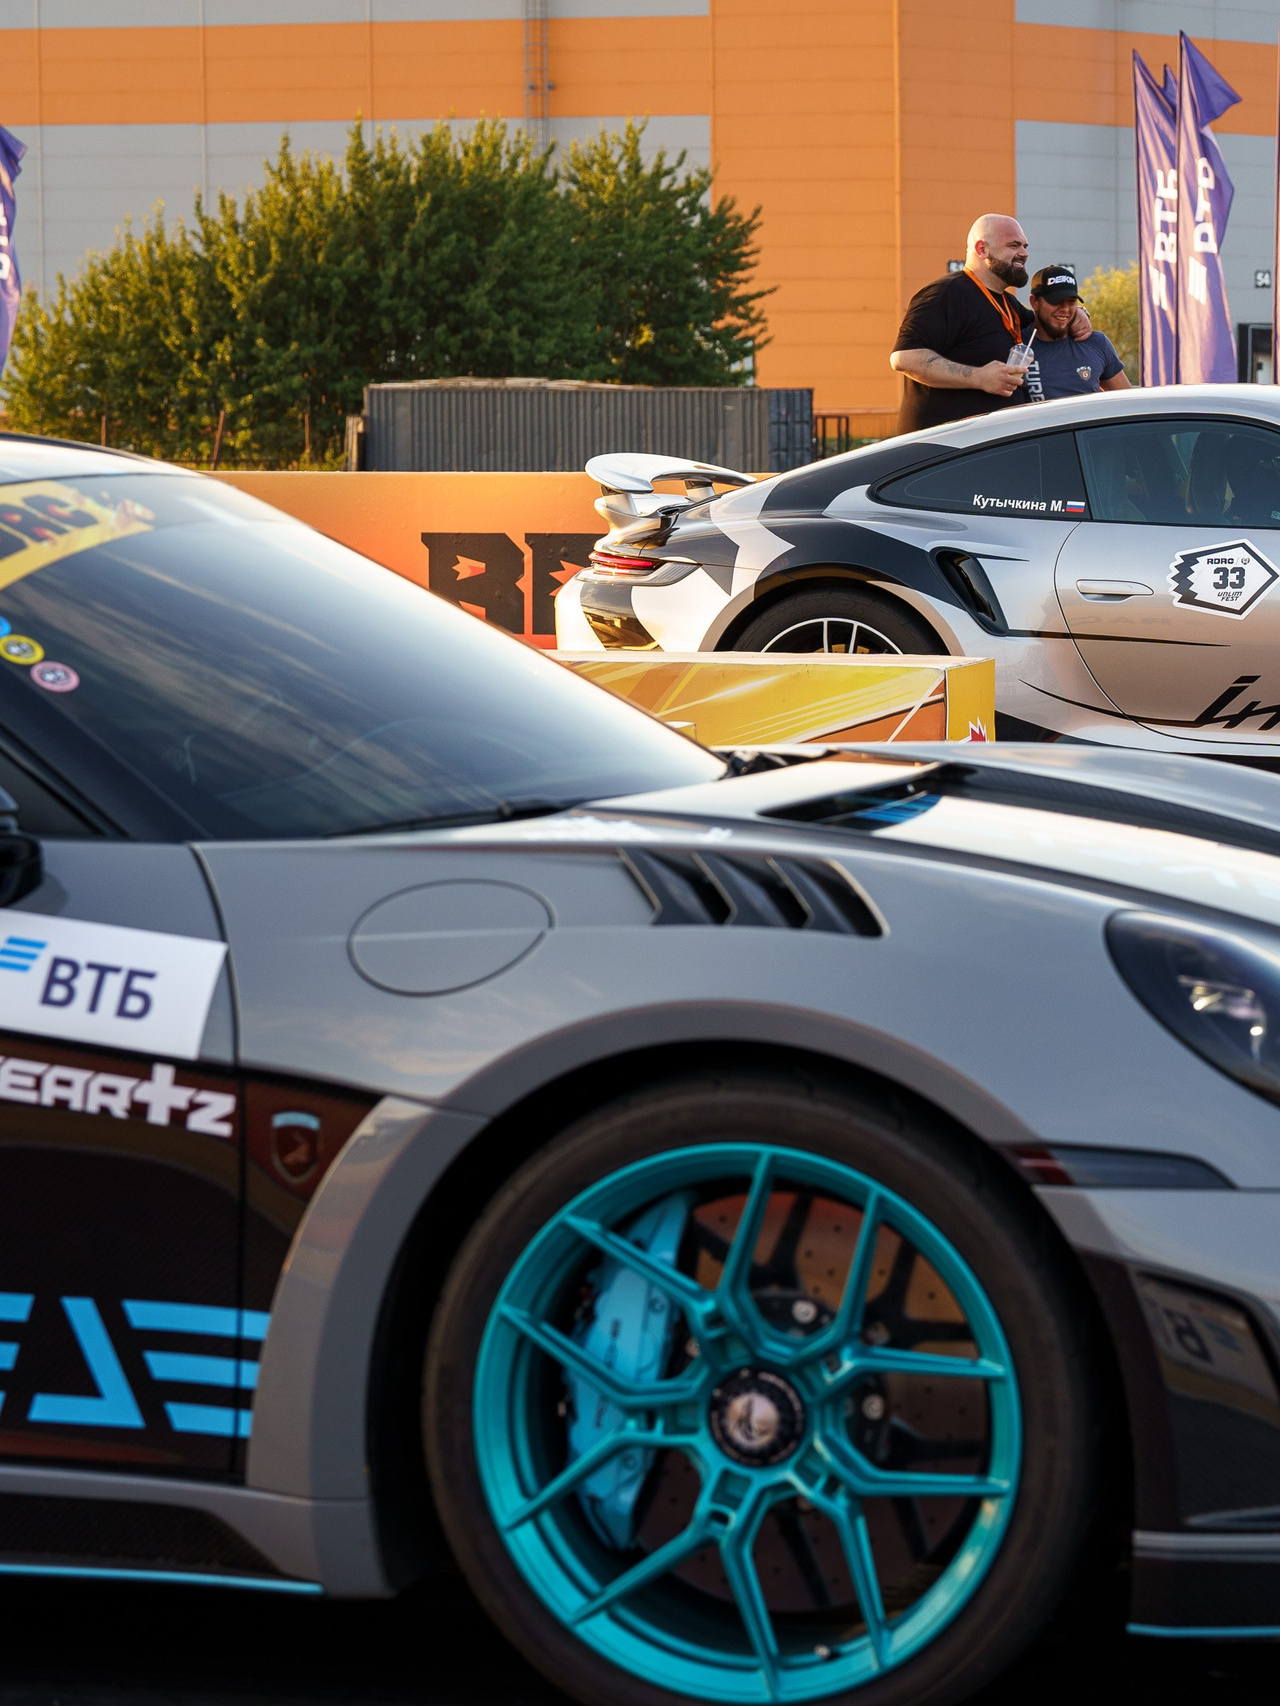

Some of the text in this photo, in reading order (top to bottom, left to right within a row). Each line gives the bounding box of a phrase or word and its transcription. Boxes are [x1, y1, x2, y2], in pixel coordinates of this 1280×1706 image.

[972, 494, 1066, 513] Кутычкина М.
[1206, 557, 1235, 565] RDRC
[1212, 566, 1246, 590] 33
[39, 955, 159, 1021] ВТБ
